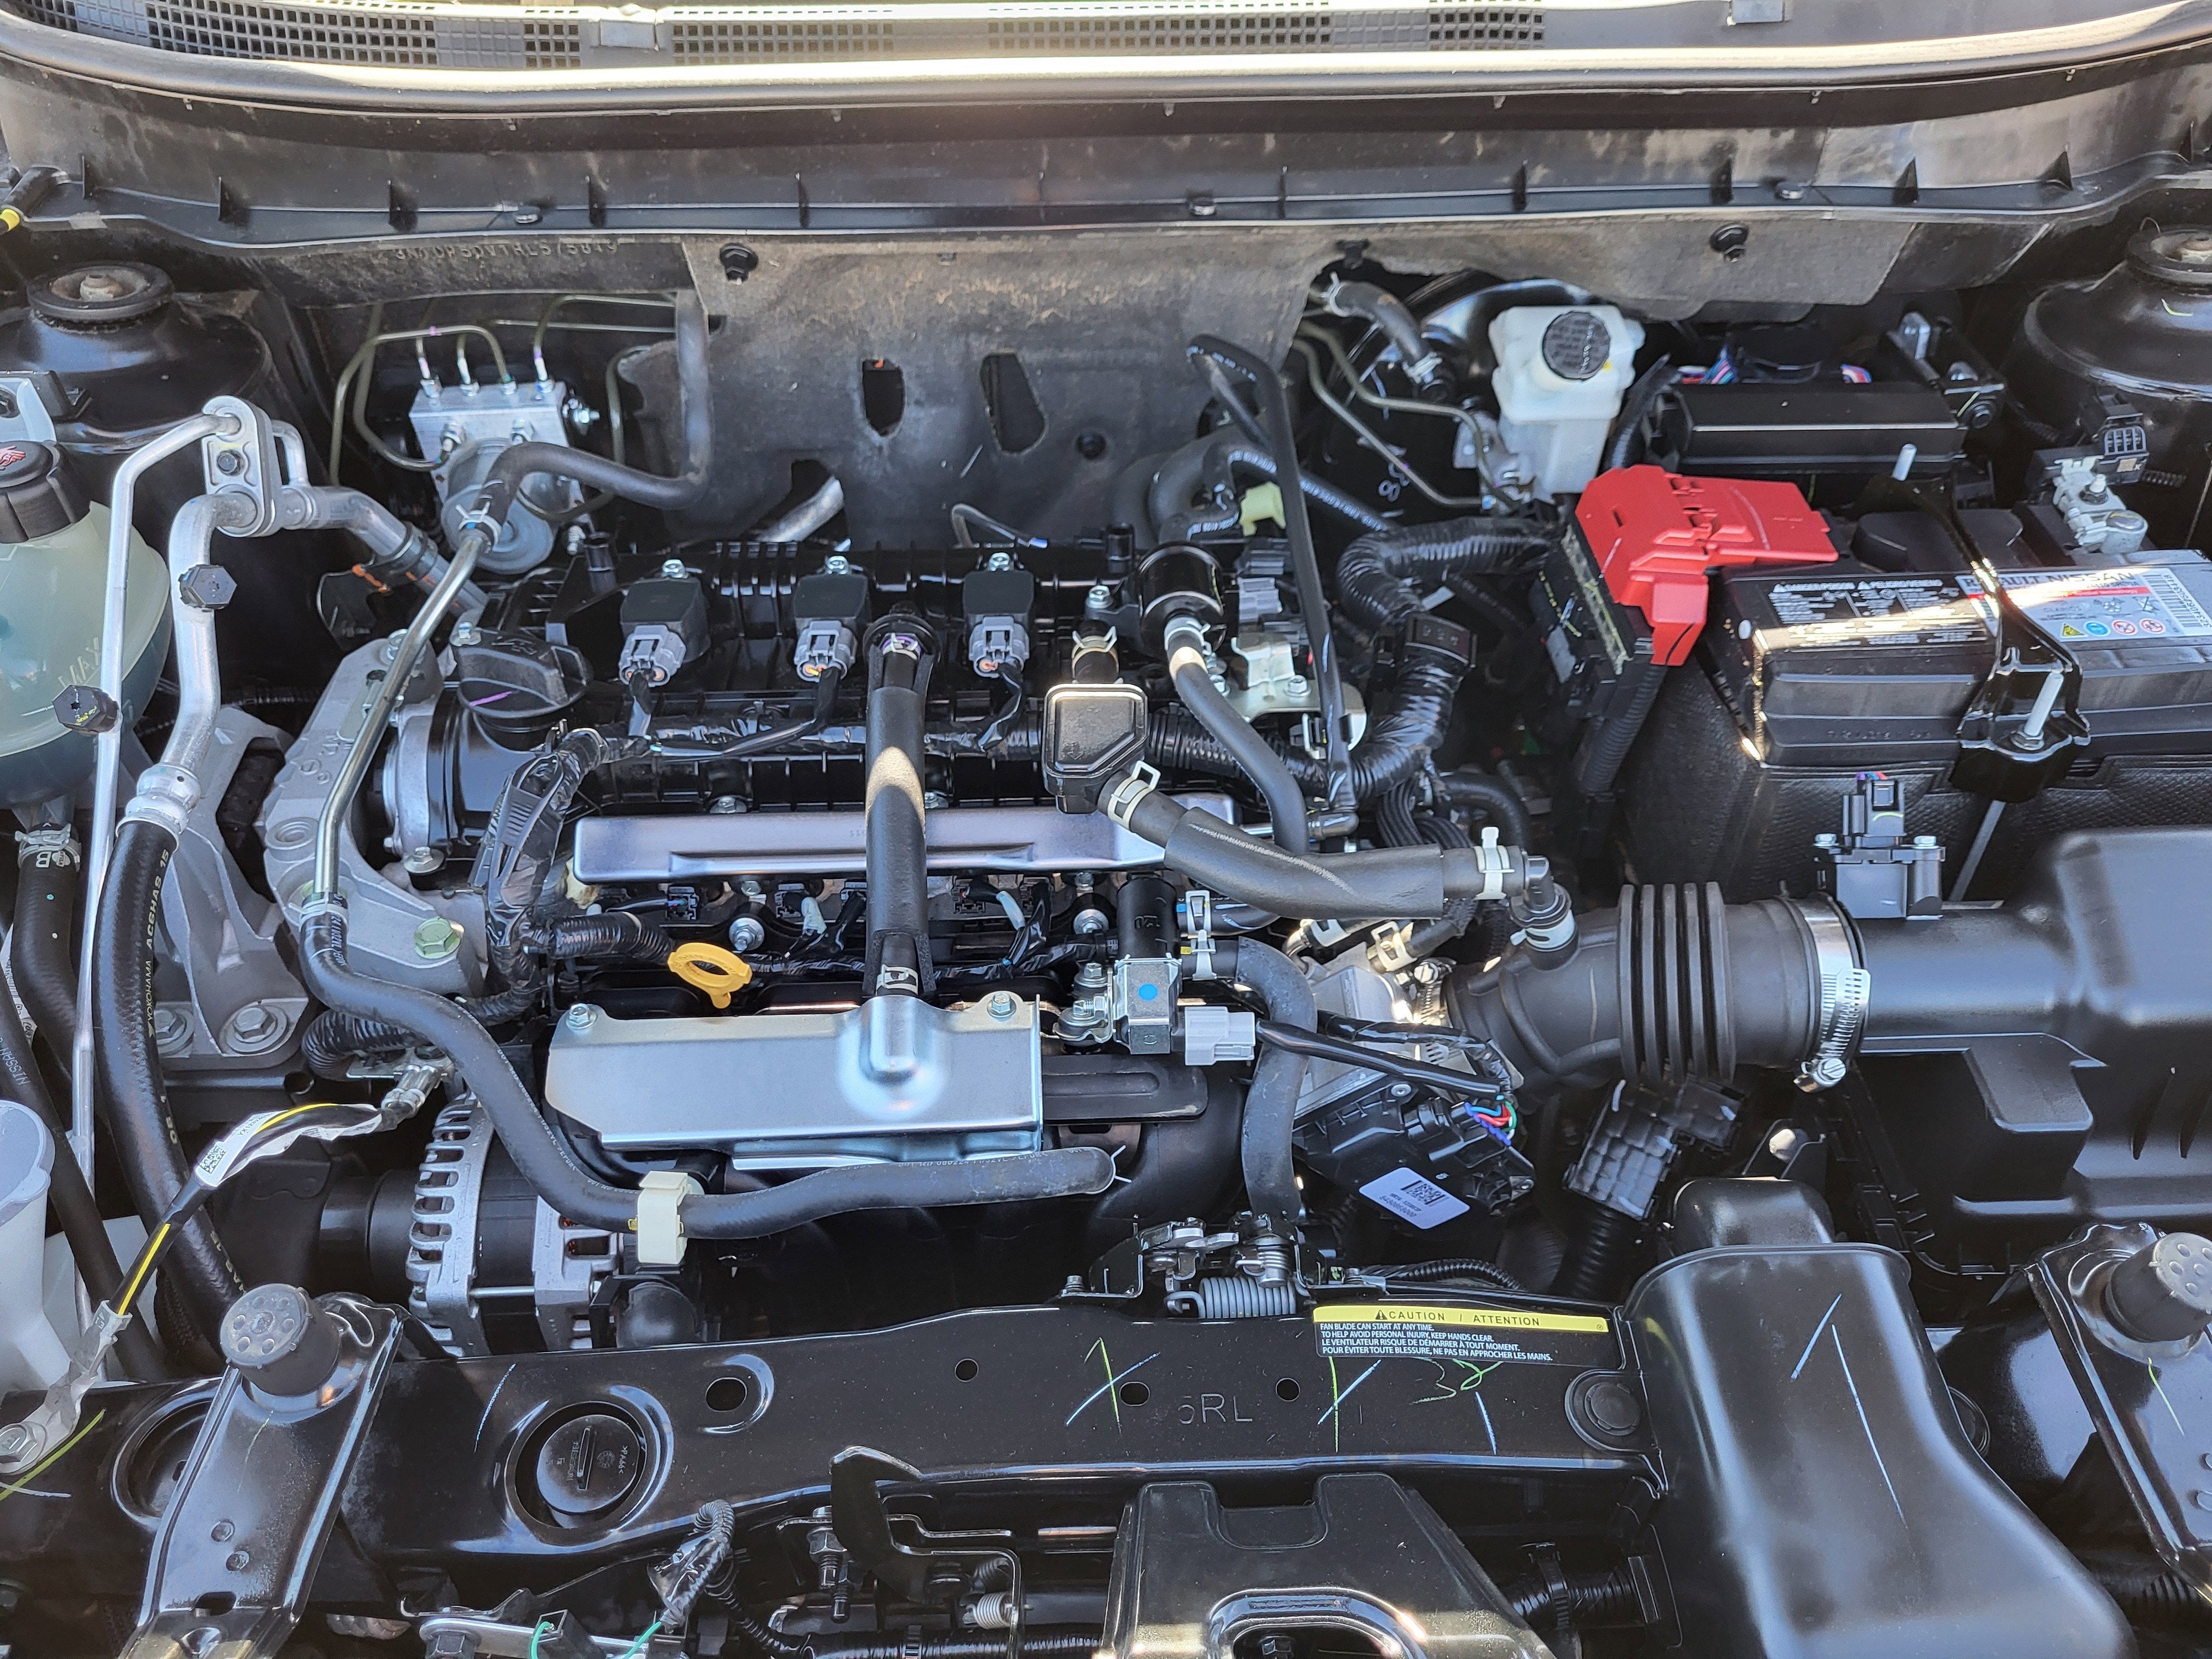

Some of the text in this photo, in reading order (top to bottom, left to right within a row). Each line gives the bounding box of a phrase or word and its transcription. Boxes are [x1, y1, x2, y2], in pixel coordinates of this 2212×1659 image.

[2, 1046, 31, 1086] NISSAN
[1389, 1311, 1445, 1321] CAUTION
[1473, 1314, 1540, 1326] ATTENTION
[1419, 1339, 1458, 1347] DÉMARRER
[1459, 1340, 1465, 1348] À
[1485, 1343, 1521, 1352] MOMENT.
[1472, 1334, 1494, 1342] CLEAR.
[1344, 1345, 1370, 1354] ÉVITER
[1395, 1347, 1433, 1355] BLESSURE,
[1469, 1349, 1514, 1359] APPROCHER
[1527, 1353, 1553, 1361] MAINS.
